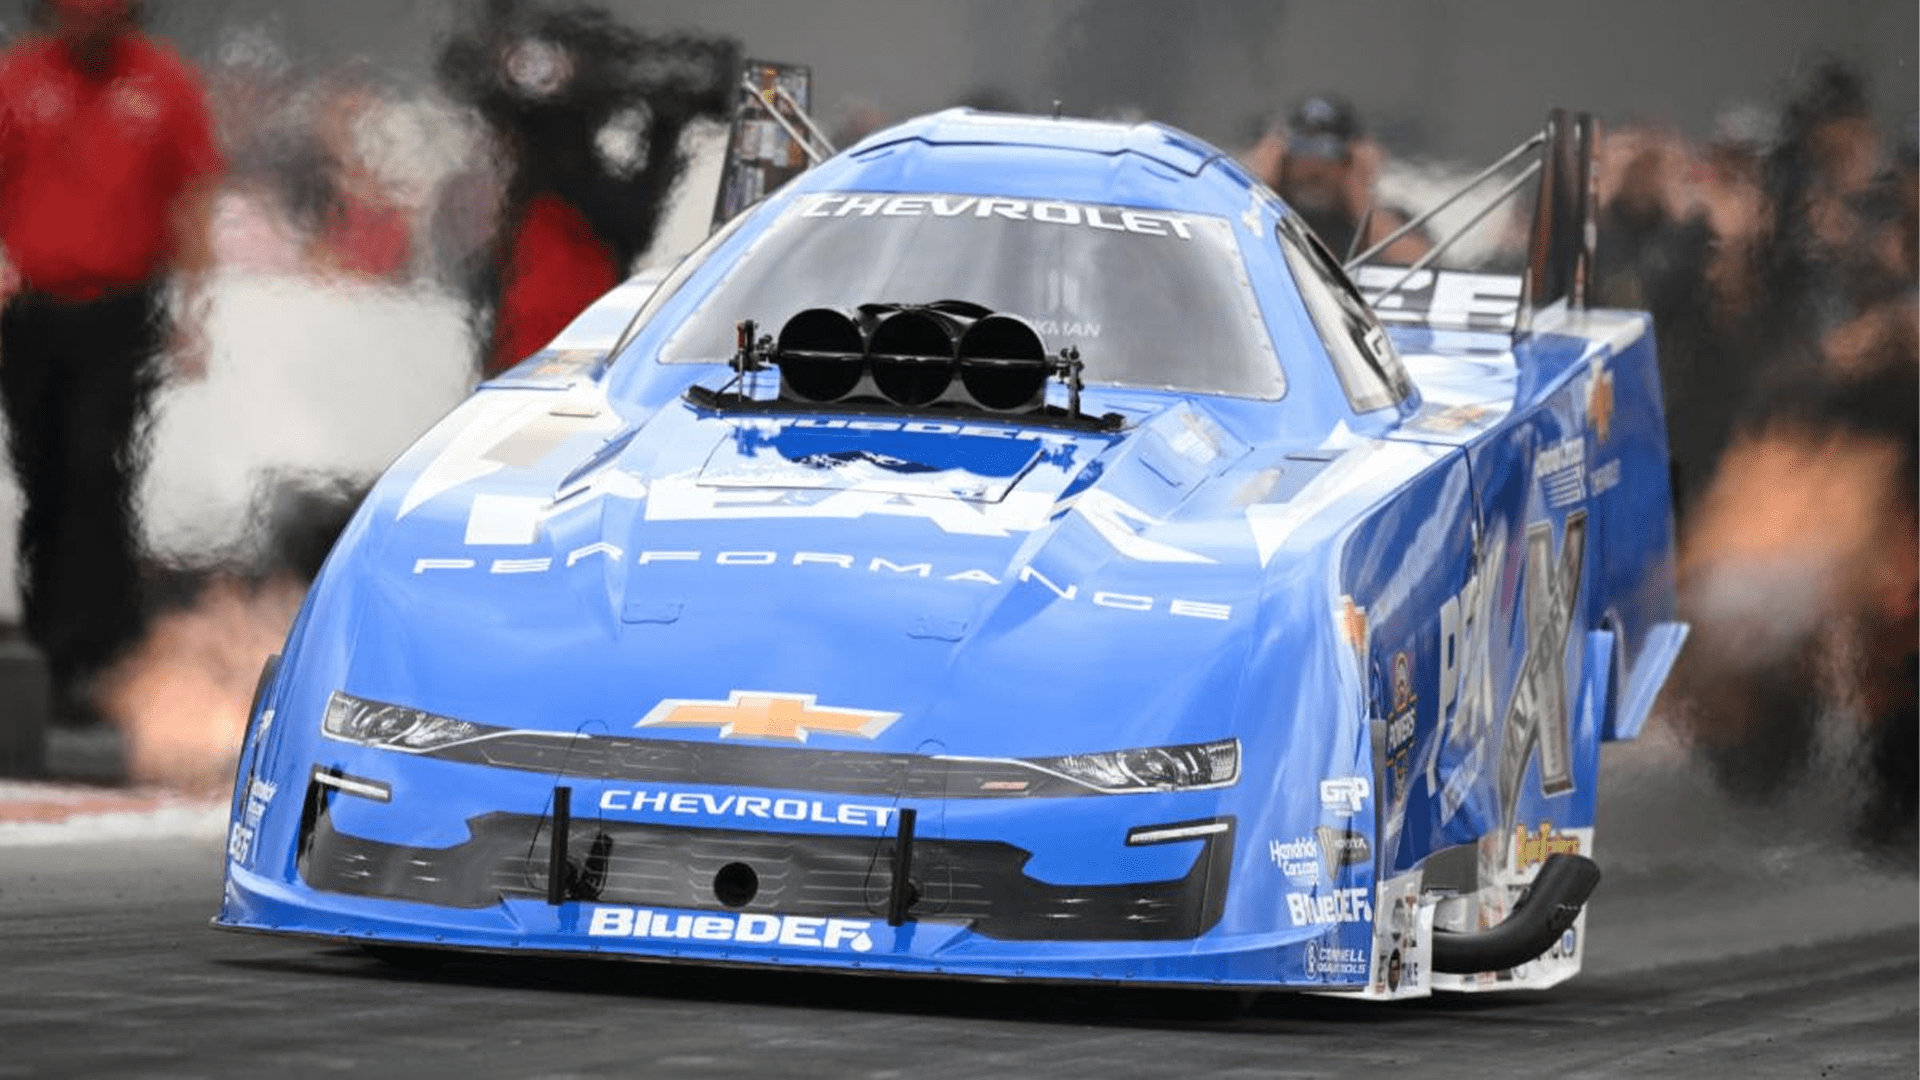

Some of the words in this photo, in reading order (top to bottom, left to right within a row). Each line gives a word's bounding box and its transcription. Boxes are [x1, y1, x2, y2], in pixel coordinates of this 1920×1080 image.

[802, 195, 1193, 240] CHEVROLET
[1030, 320, 1101, 337] KMAN
[413, 542, 1231, 620] PERFORMANCE
[600, 789, 896, 828] CHEVROLET
[1320, 777, 1370, 812] GRP
[1287, 887, 1371, 926] BlueDEF
[588, 907, 872, 951] BlueDEF
